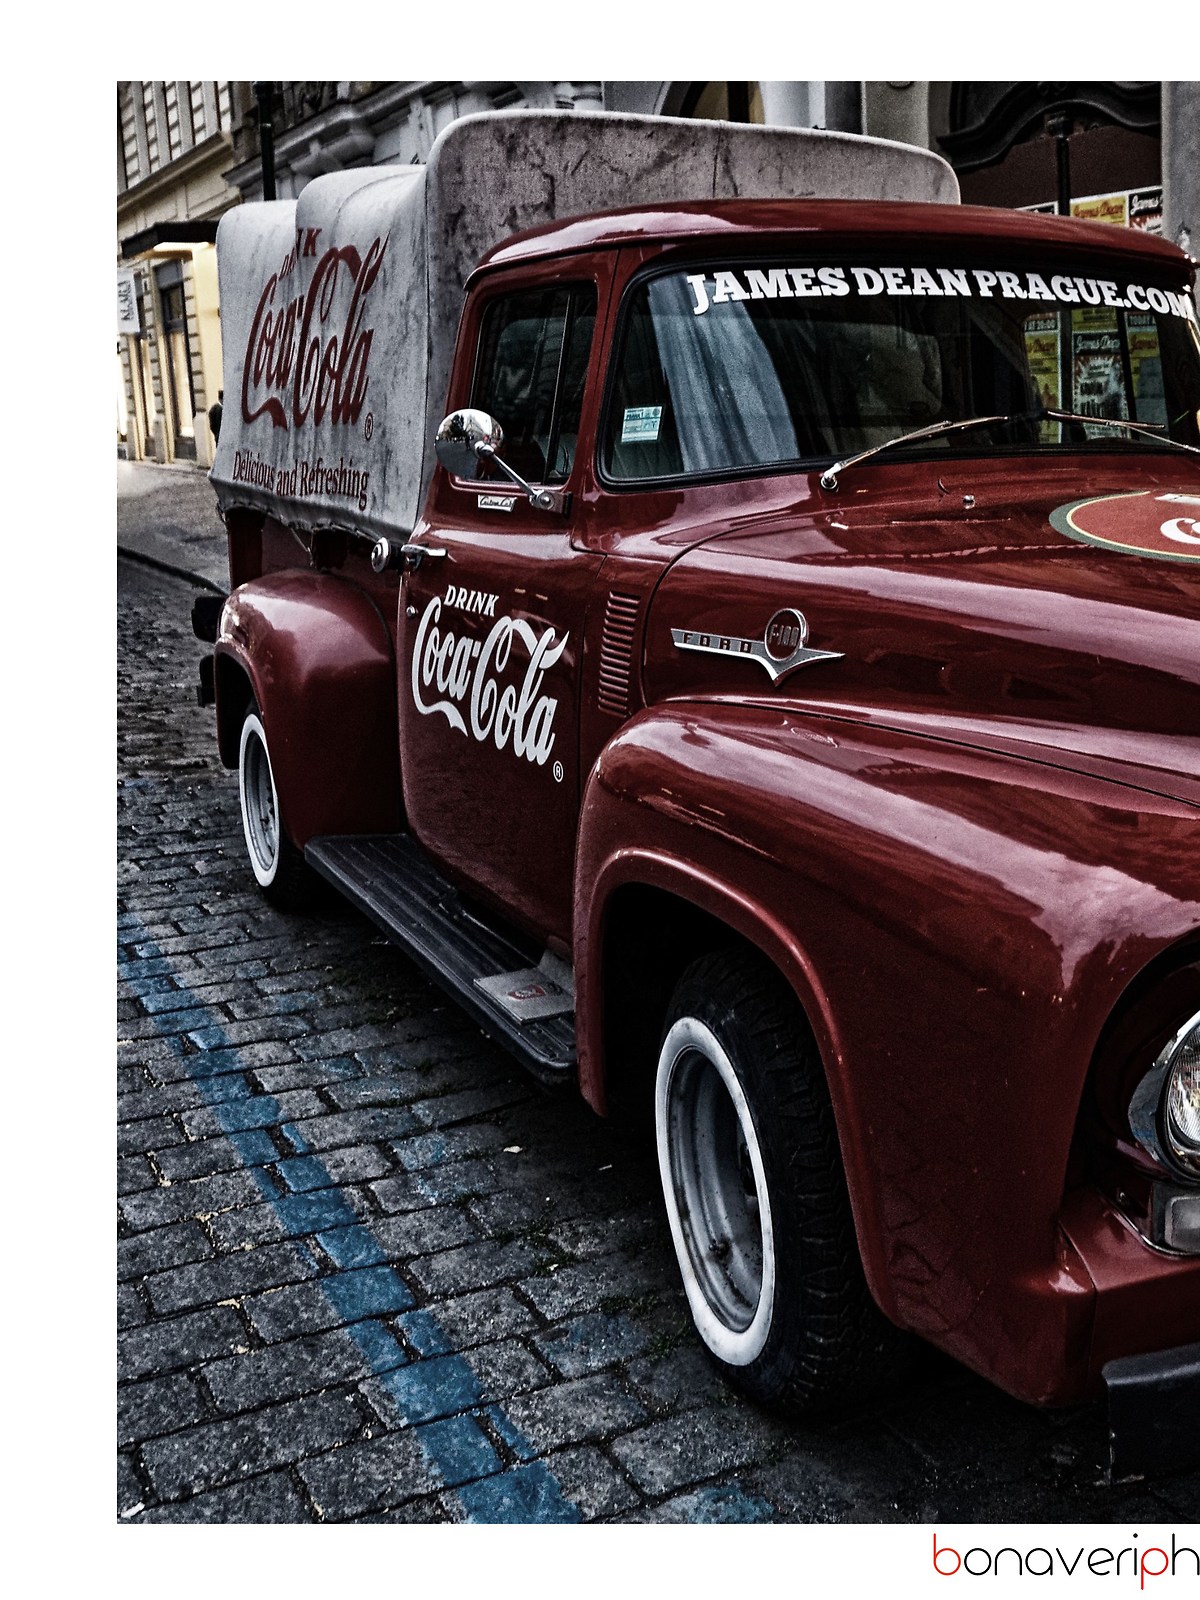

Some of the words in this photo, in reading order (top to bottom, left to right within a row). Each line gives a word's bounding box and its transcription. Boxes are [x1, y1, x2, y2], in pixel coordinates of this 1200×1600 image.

[278, 228, 322, 281] DRNK
[687, 267, 848, 315] JAMES
[851, 267, 971, 297] DEAN
[972, 270, 1194, 322] PRAGUE.COM
[241, 229, 391, 431] Coca-Cola
[232, 449, 275, 492] Delicious
[276, 458, 298, 497] and
[299, 456, 370, 512] Refreshing
[444, 584, 499, 617] DRINK
[682, 632, 753, 654] FORD
[412, 596, 570, 766] Coca-Cola
